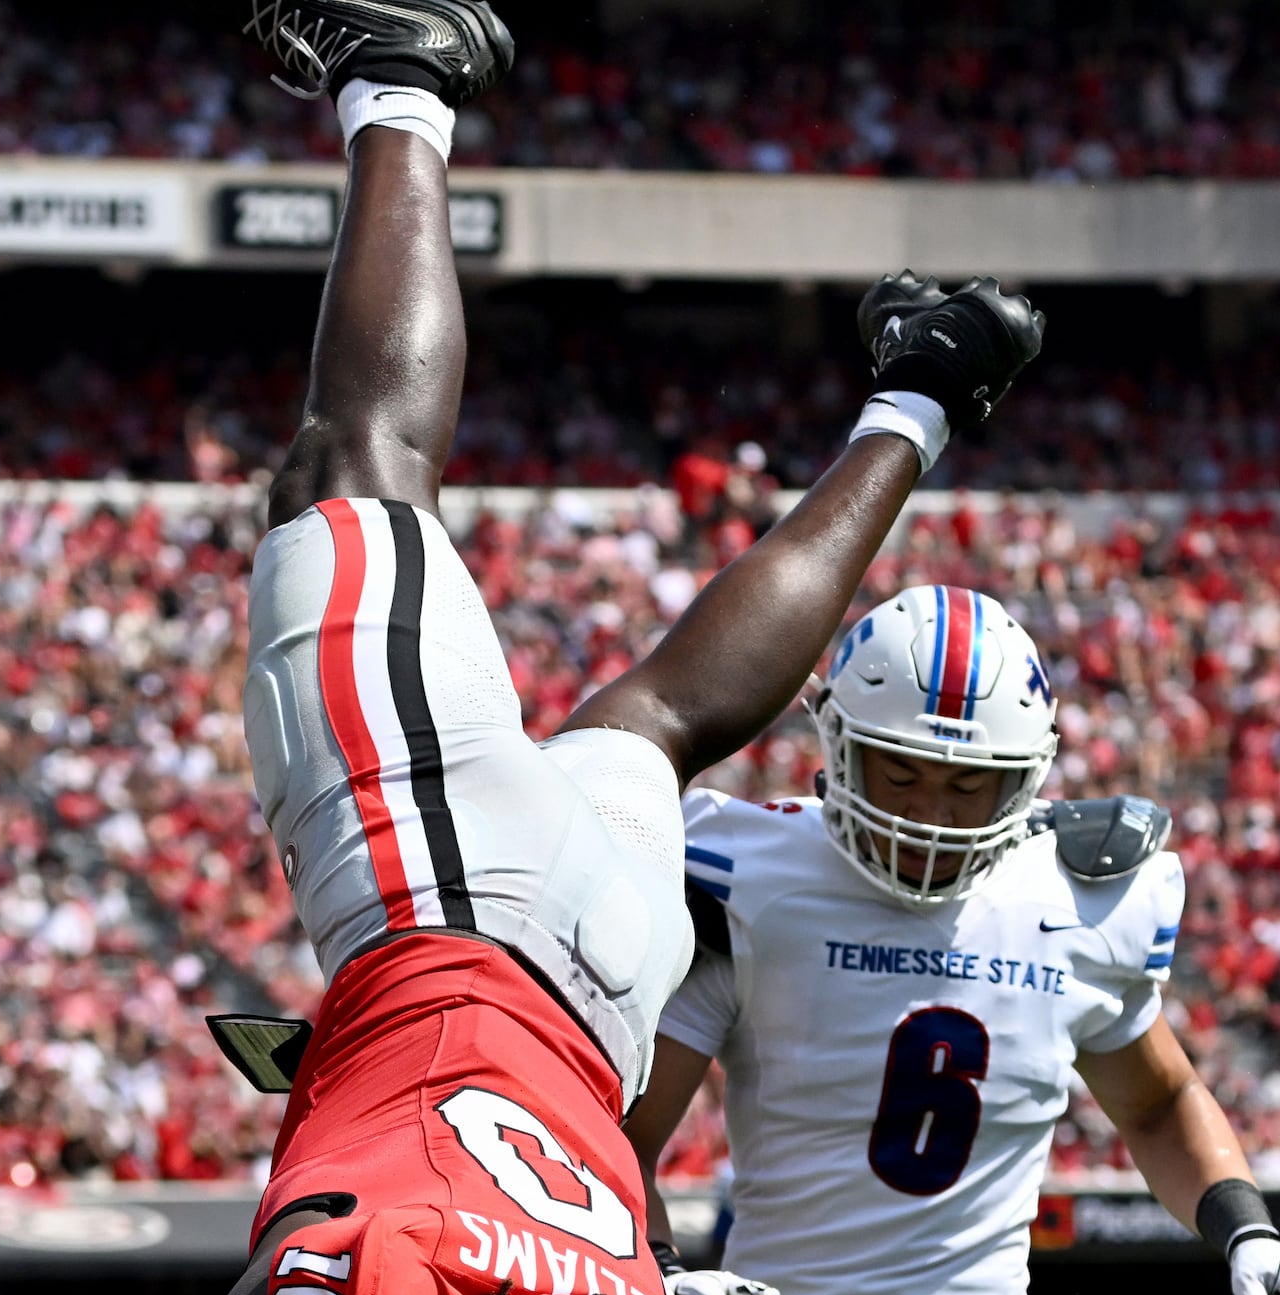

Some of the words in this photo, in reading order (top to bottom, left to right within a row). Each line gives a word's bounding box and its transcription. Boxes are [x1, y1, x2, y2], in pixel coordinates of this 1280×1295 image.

[826, 940, 980, 980] TENNESSEE
[987, 958, 1066, 995] STATE
[868, 1005, 990, 1198] 6
